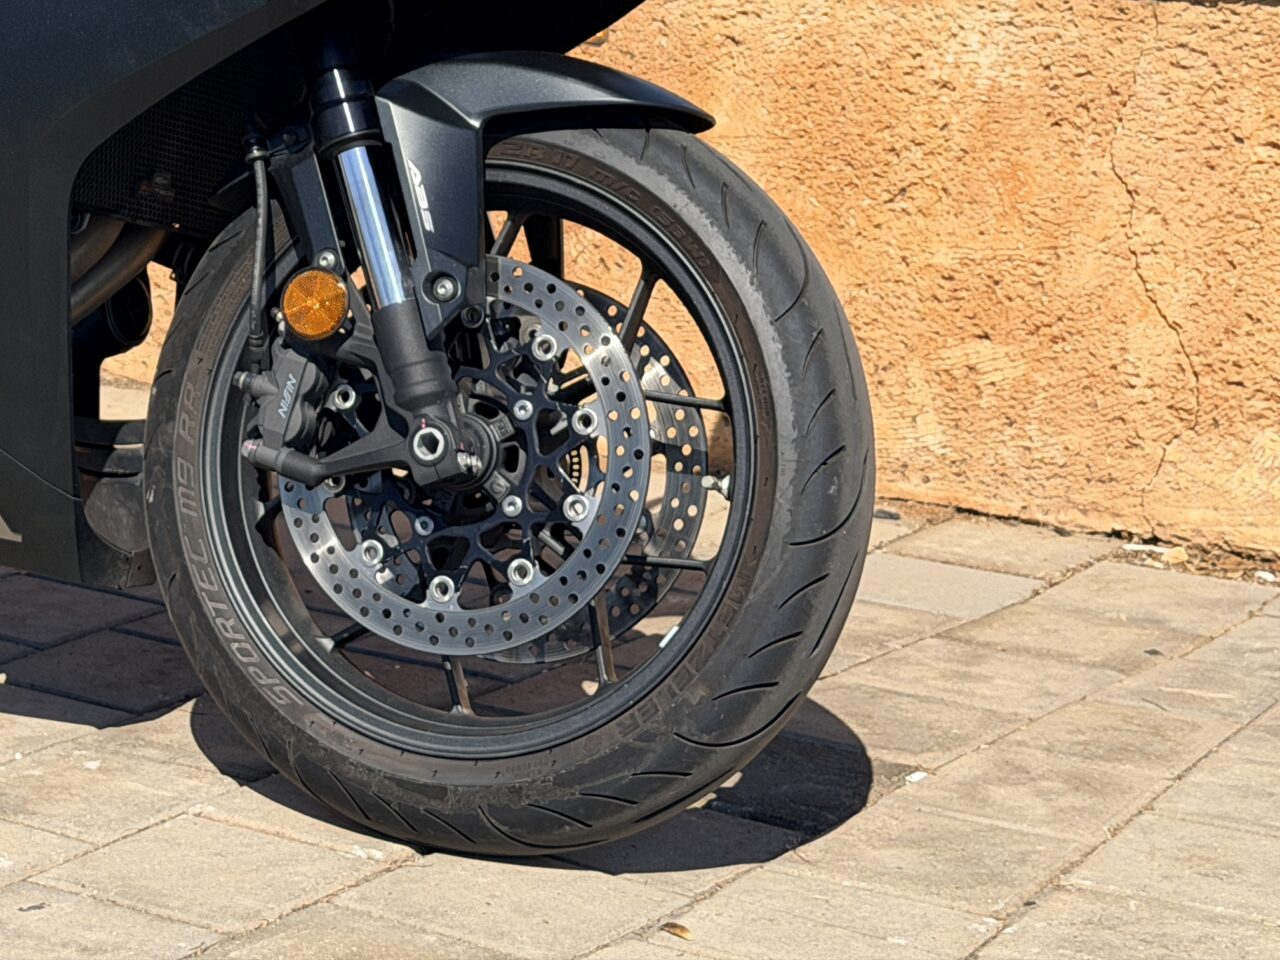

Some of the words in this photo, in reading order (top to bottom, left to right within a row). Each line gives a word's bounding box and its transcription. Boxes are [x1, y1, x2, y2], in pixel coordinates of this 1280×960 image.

[407, 159, 435, 234] ABS
[178, 382, 201, 448] RR
[175, 458, 199, 524] M9
[182, 536, 306, 707] SPORTEC
